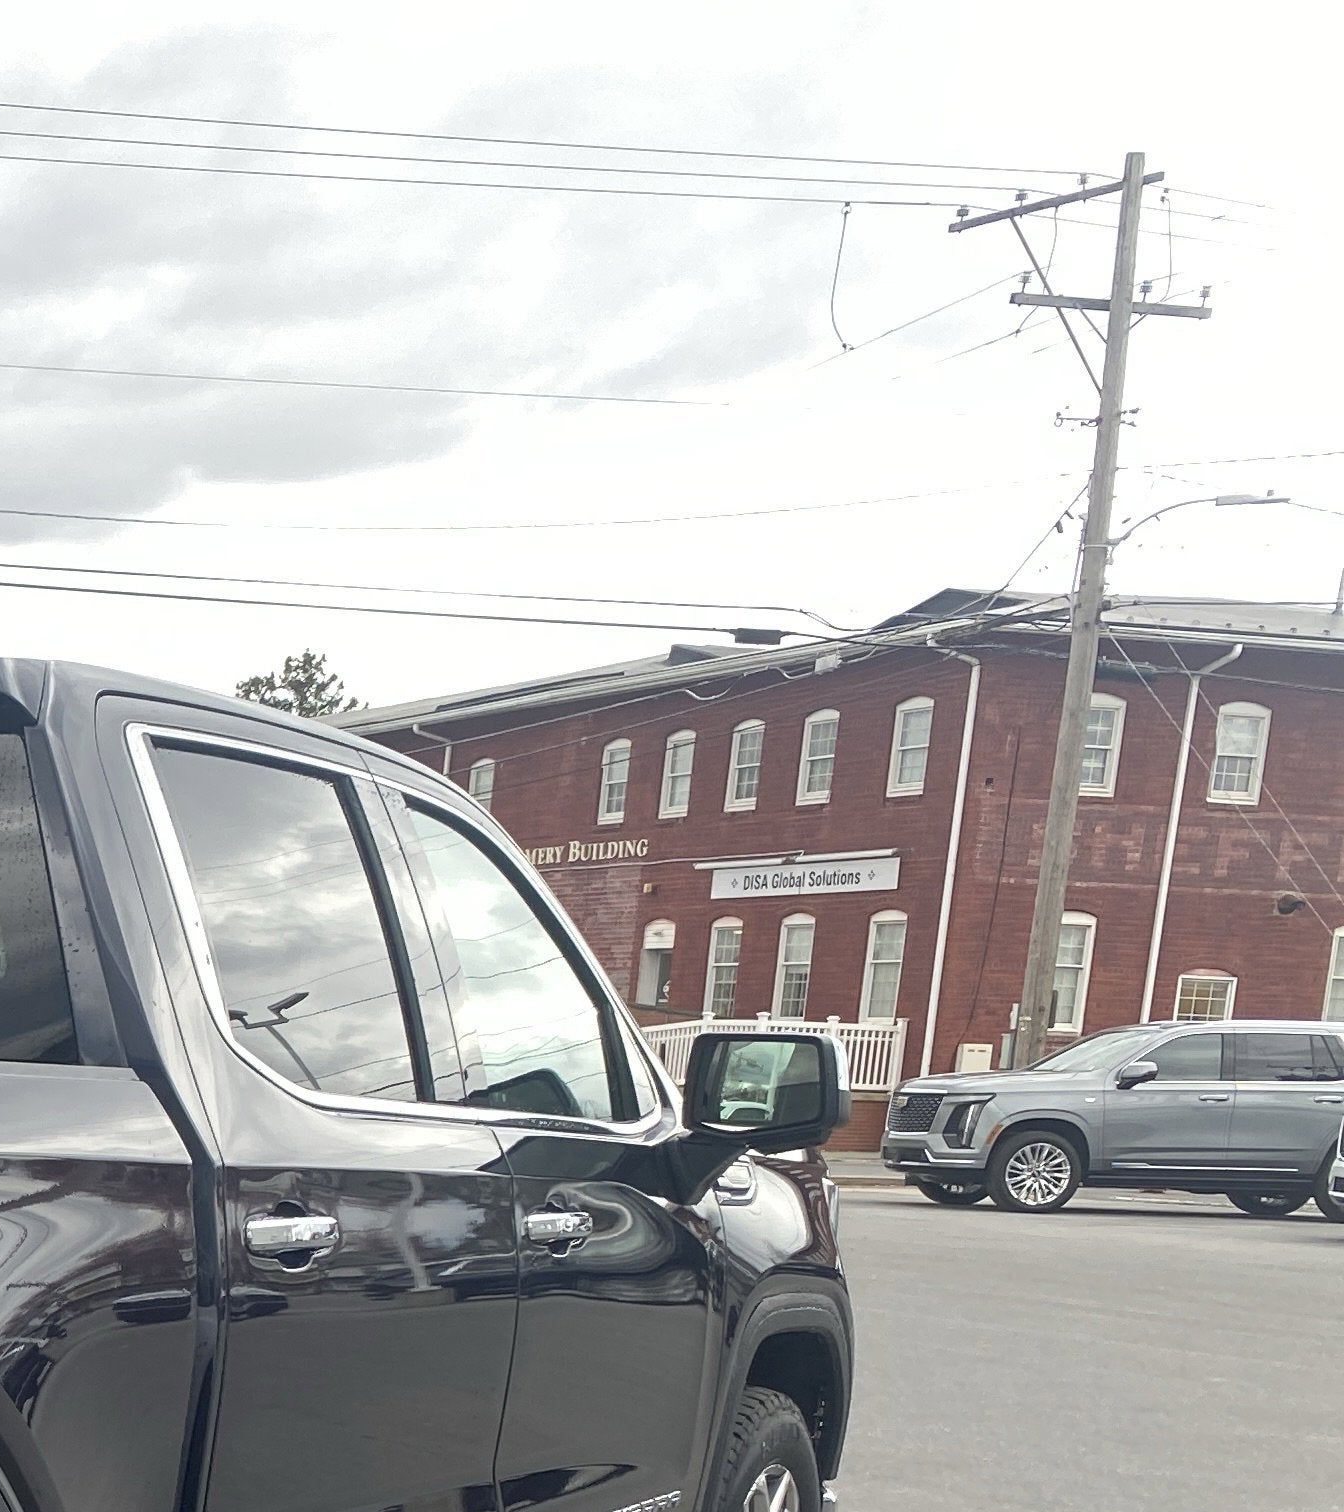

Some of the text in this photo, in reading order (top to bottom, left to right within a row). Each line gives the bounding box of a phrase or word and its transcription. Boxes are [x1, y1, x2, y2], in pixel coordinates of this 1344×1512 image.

[743, 867, 861, 891] DISA Global Solutions
